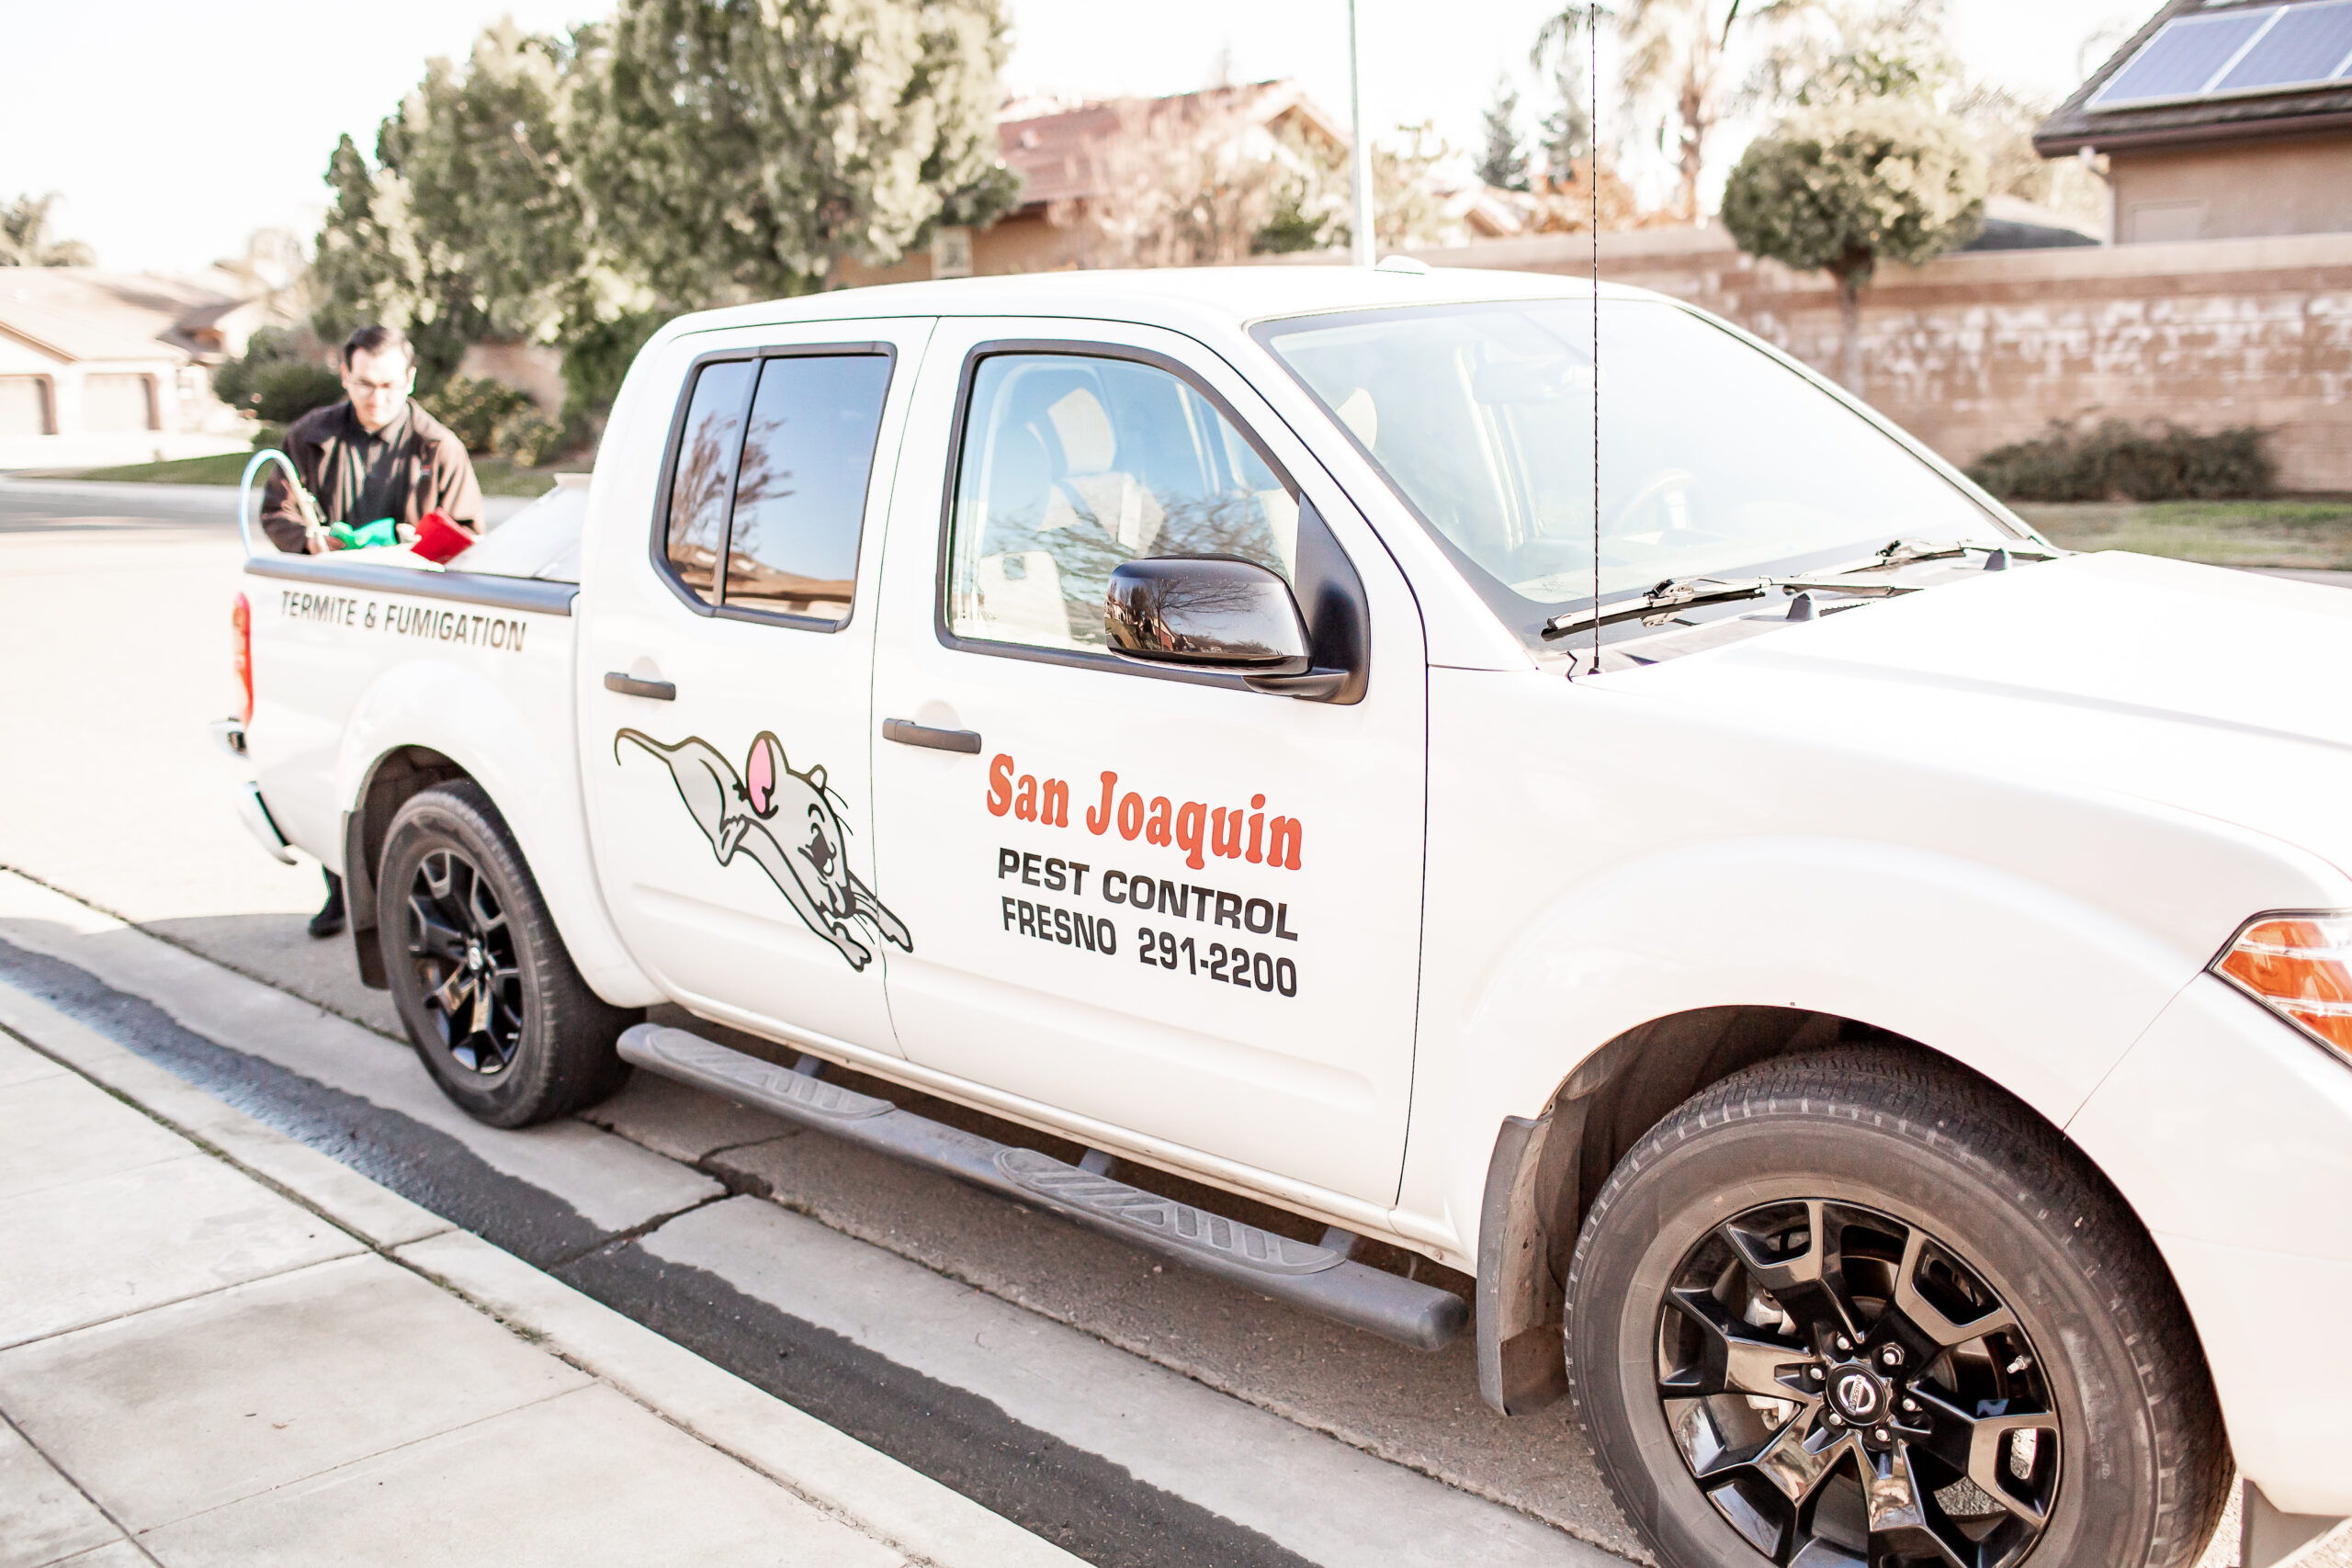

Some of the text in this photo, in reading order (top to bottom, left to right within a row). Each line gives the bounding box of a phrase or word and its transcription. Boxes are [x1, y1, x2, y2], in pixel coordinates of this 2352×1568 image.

[282, 591, 526, 651] TERMITE & FUMIGATION
[987, 753, 1302, 870] San Joaquin
[999, 848, 1298, 942] PEST CONTROL
[1001, 896, 1297, 998] FRESNO 291-2200
[1848, 1379, 1863, 1414] NISSAN
